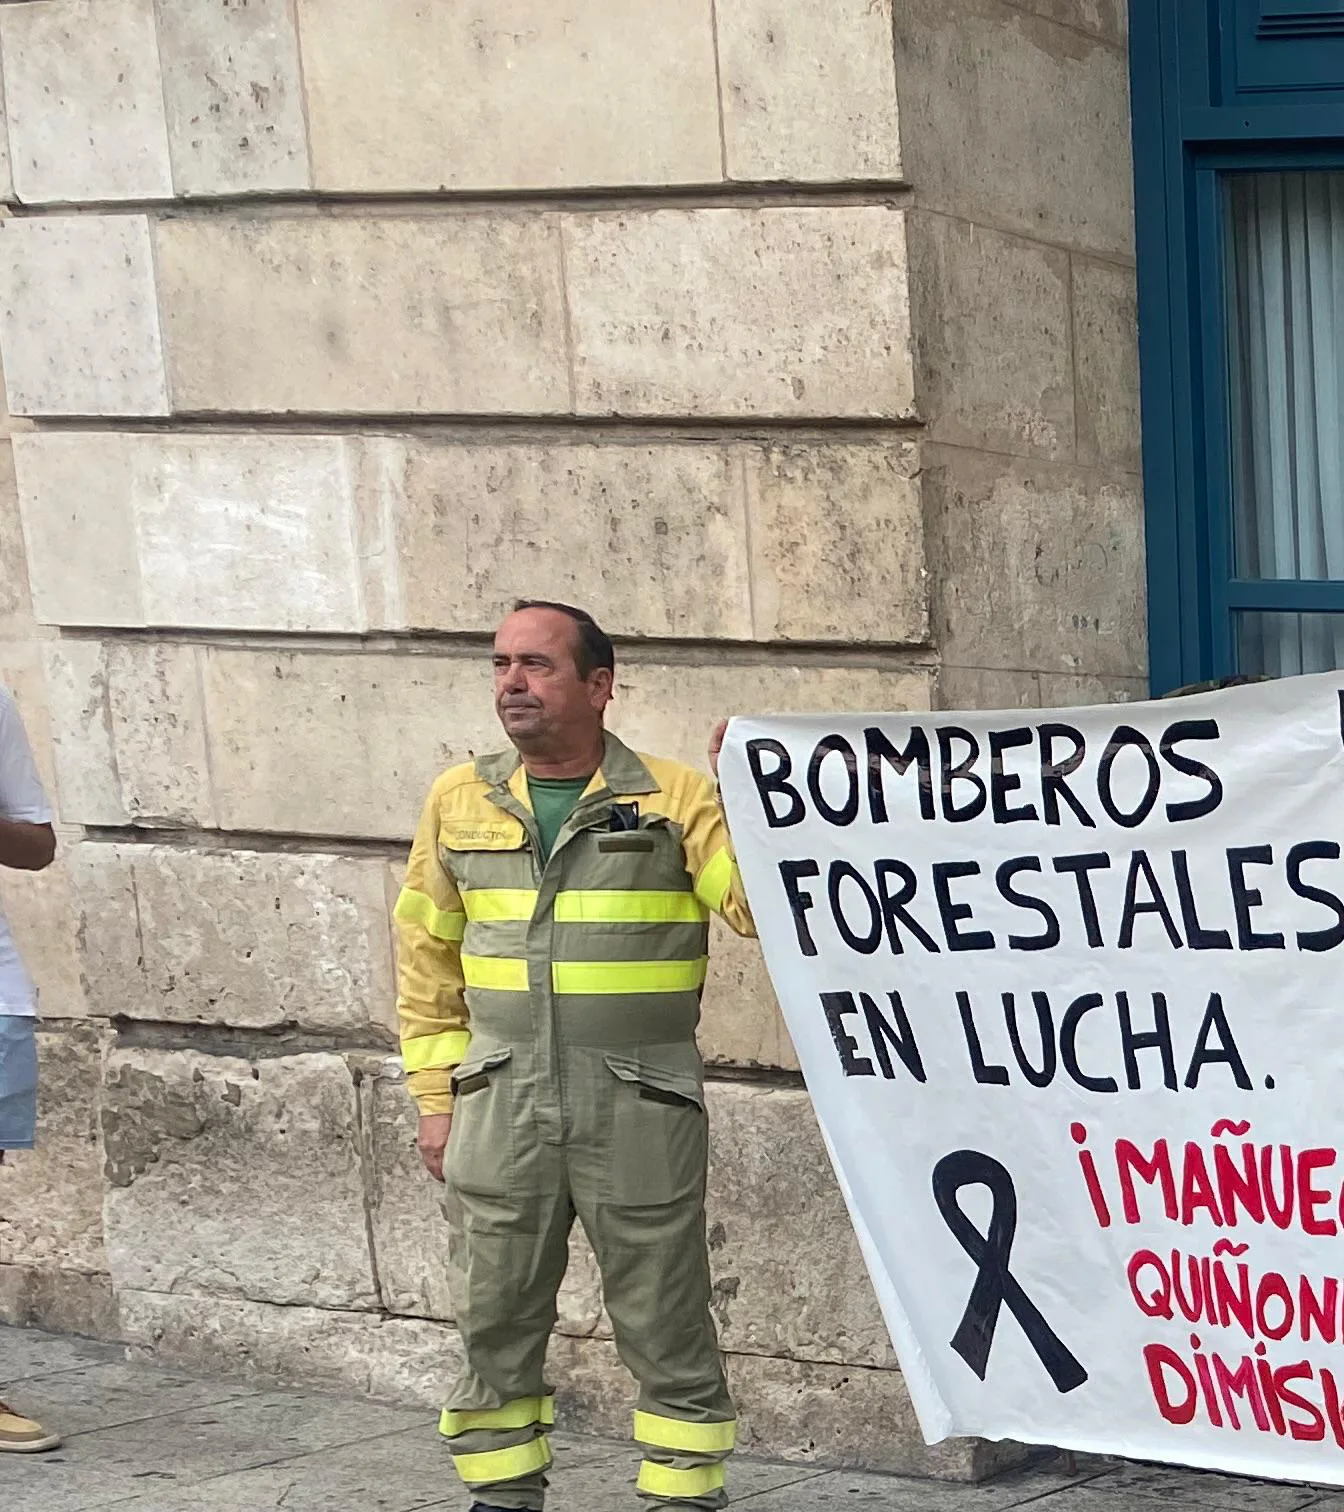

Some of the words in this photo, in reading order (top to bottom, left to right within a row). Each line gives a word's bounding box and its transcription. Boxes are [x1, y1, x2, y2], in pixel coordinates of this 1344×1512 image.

[746, 719, 1223, 828] BOMBEROS
[819, 990, 927, 1084] EN
[956, 990, 1276, 1093] LUCHA.
